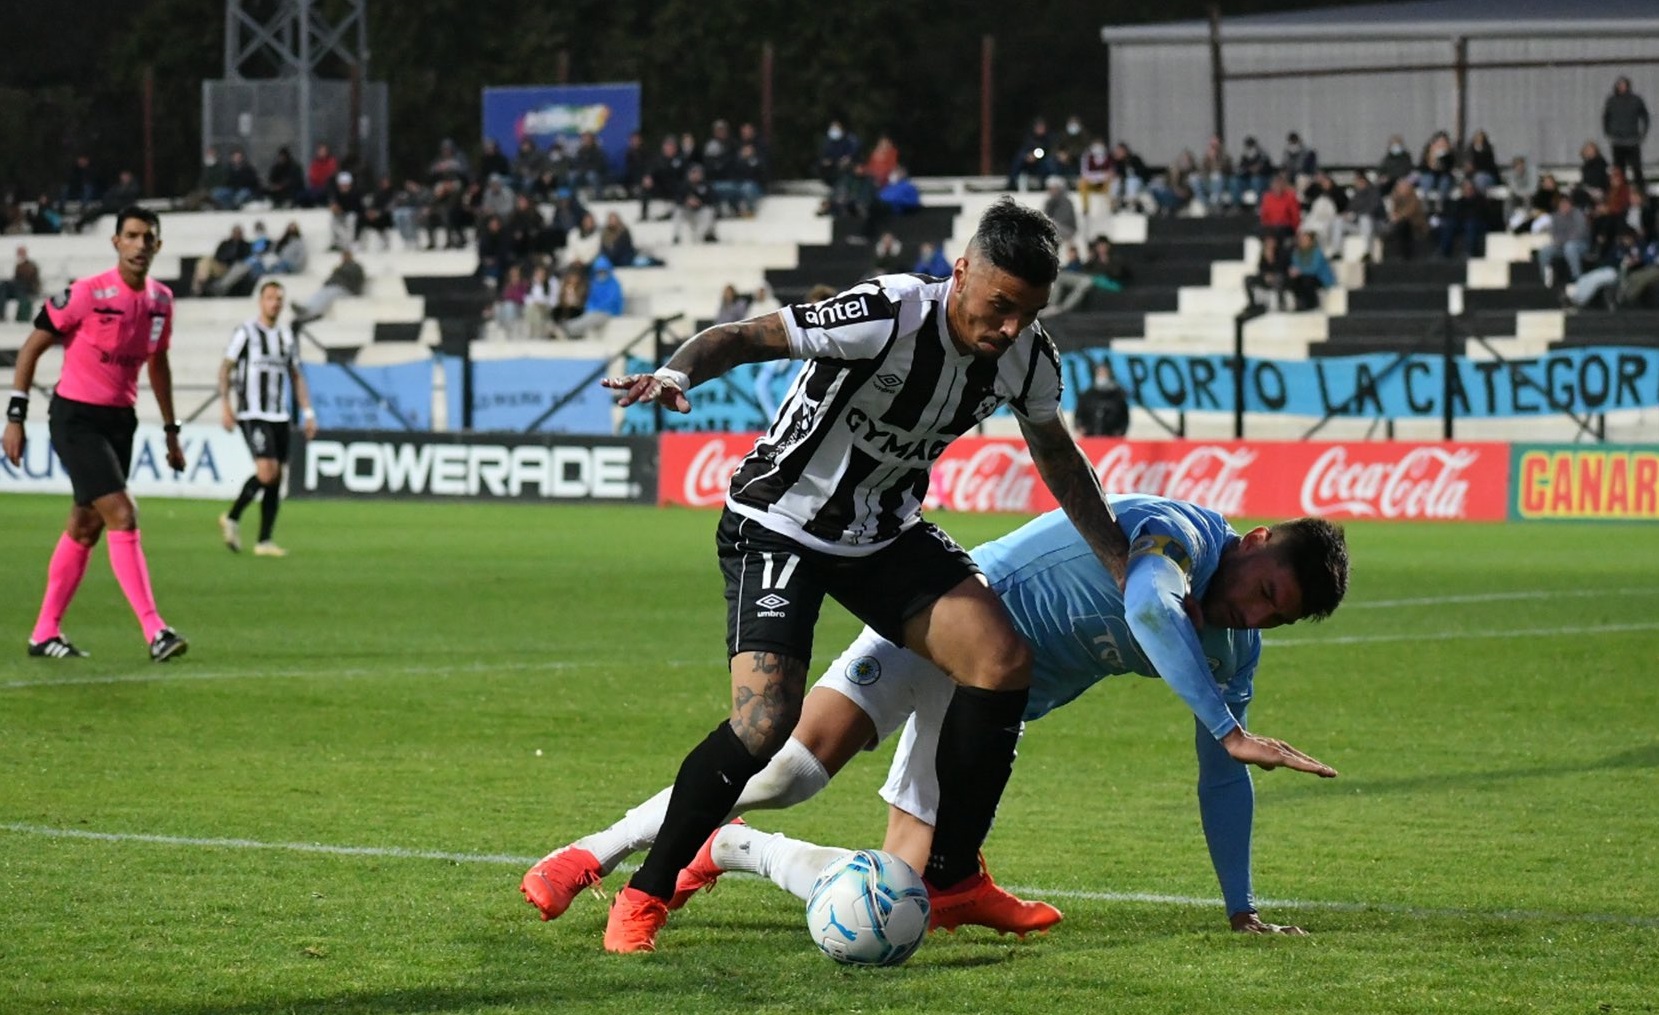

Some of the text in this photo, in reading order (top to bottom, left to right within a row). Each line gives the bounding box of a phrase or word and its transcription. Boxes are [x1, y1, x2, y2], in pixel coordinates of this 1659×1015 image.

[804, 296, 869, 326] antel
[1316, 362, 1384, 415] LA
[1403, 352, 1659, 415] CATEGOR
[304, 440, 632, 498] POWERADE
[1300, 446, 1482, 518] Coca-Cola
[759, 551, 801, 590] 17
[757, 609, 786, 618] umbro
